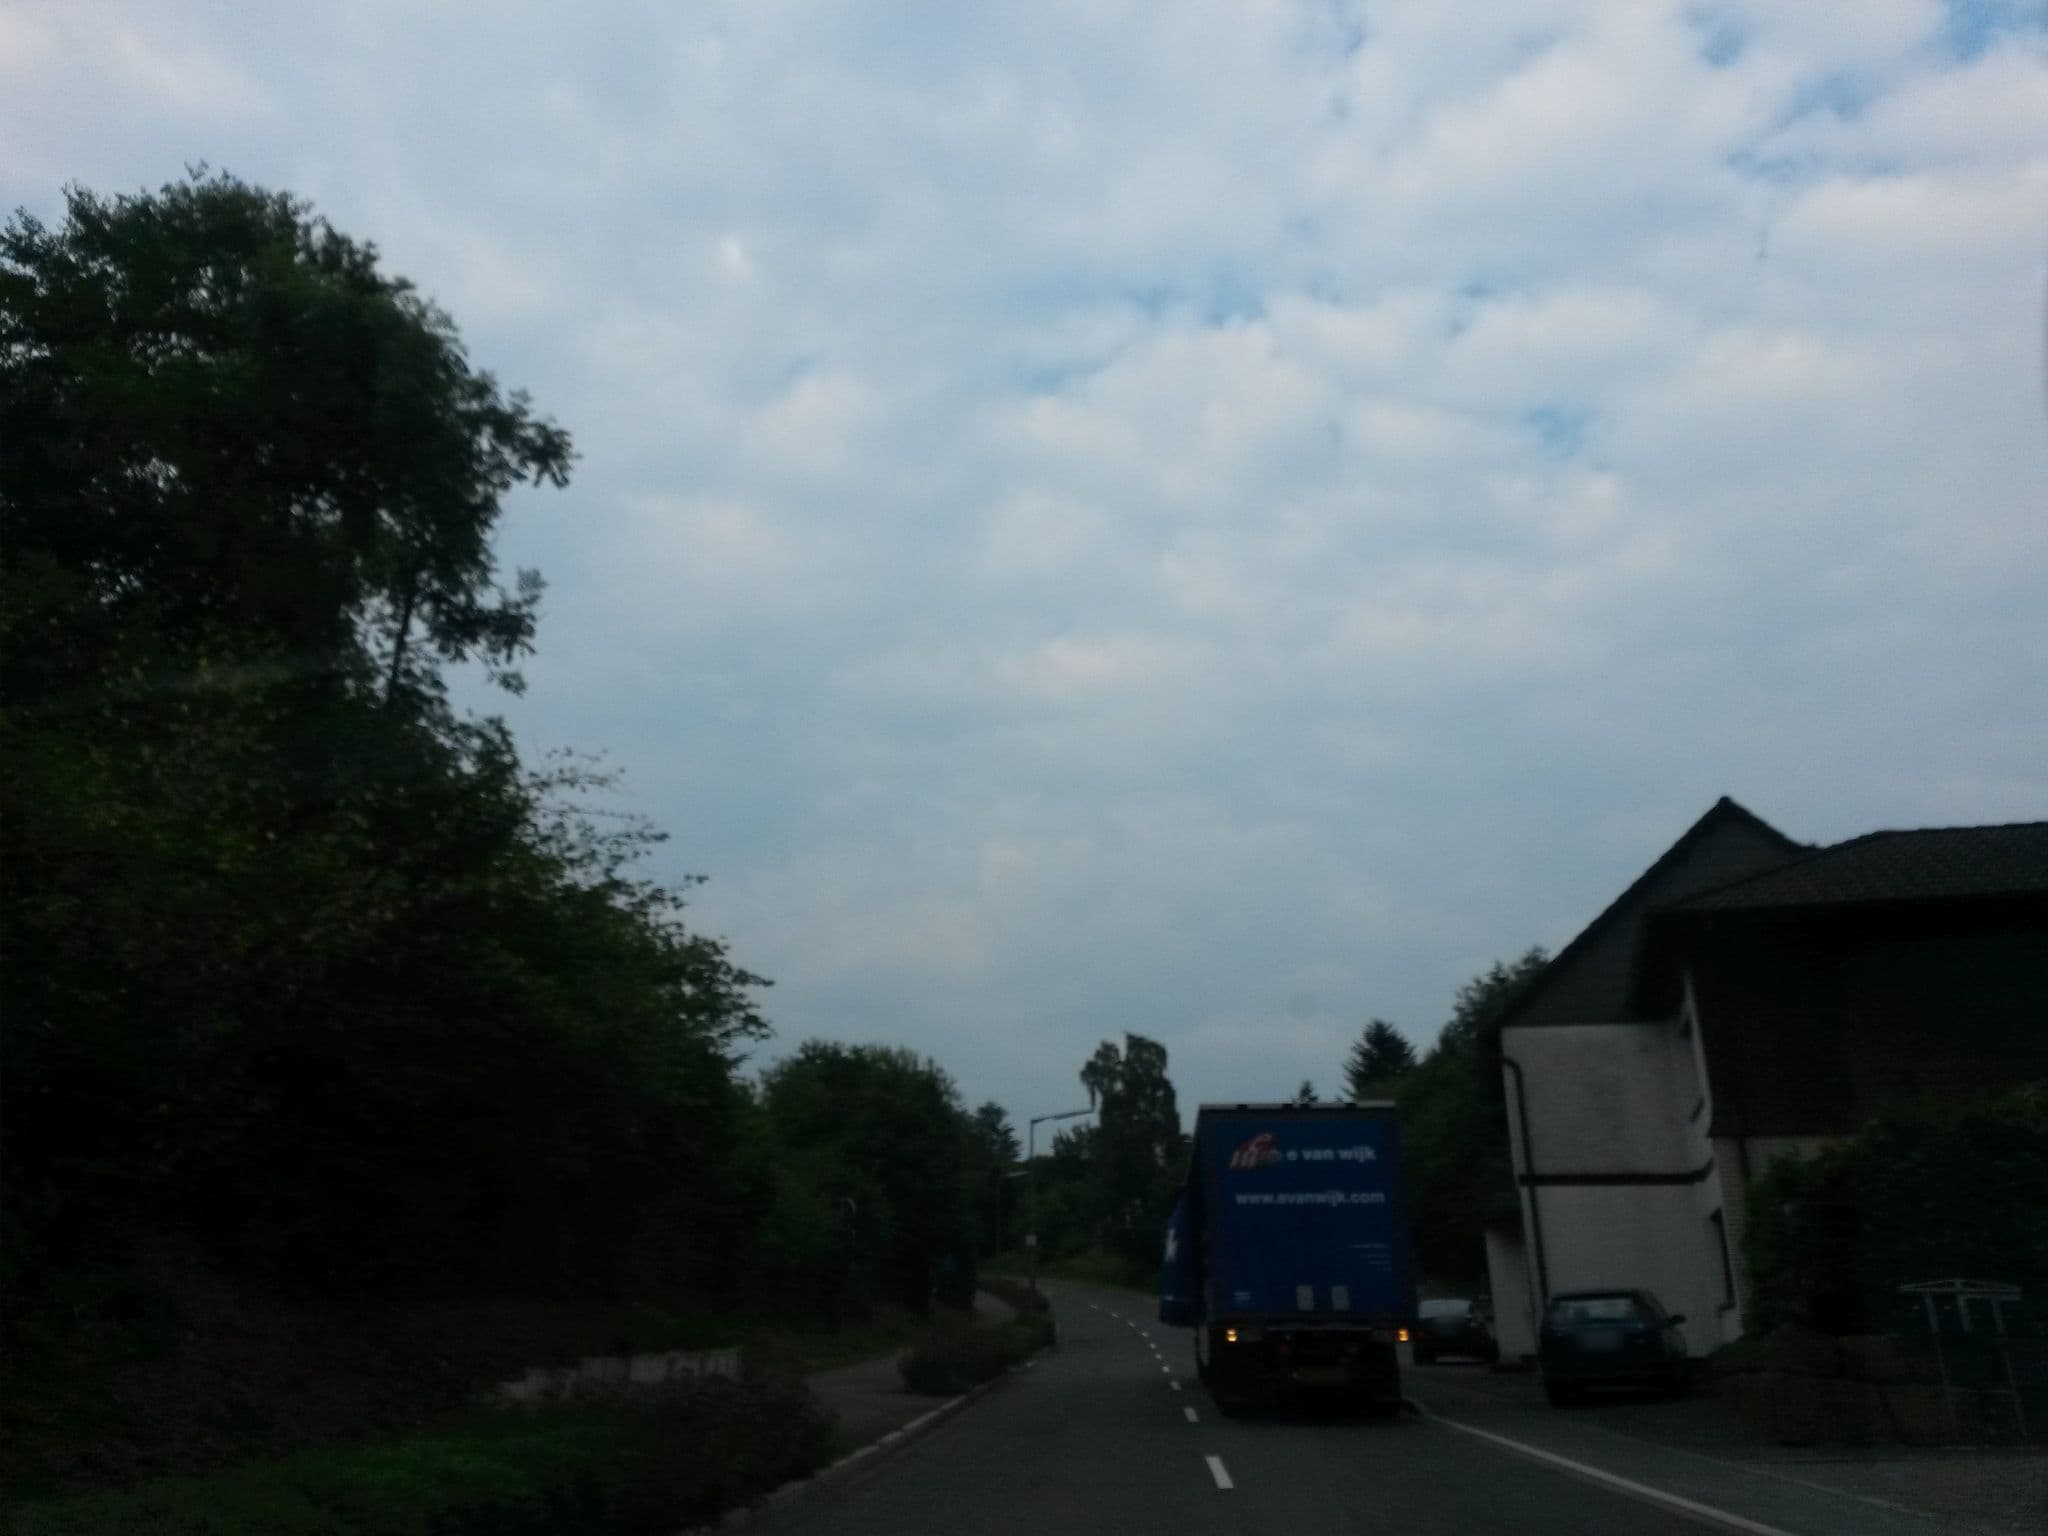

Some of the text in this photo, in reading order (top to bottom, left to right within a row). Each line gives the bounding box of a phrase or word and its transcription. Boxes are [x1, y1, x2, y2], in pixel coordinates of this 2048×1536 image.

[1301, 1147, 1335, 1161] van
[1337, 1144, 1378, 1164] wijk
[1234, 1189, 1386, 1207] www.evanwijk.com
